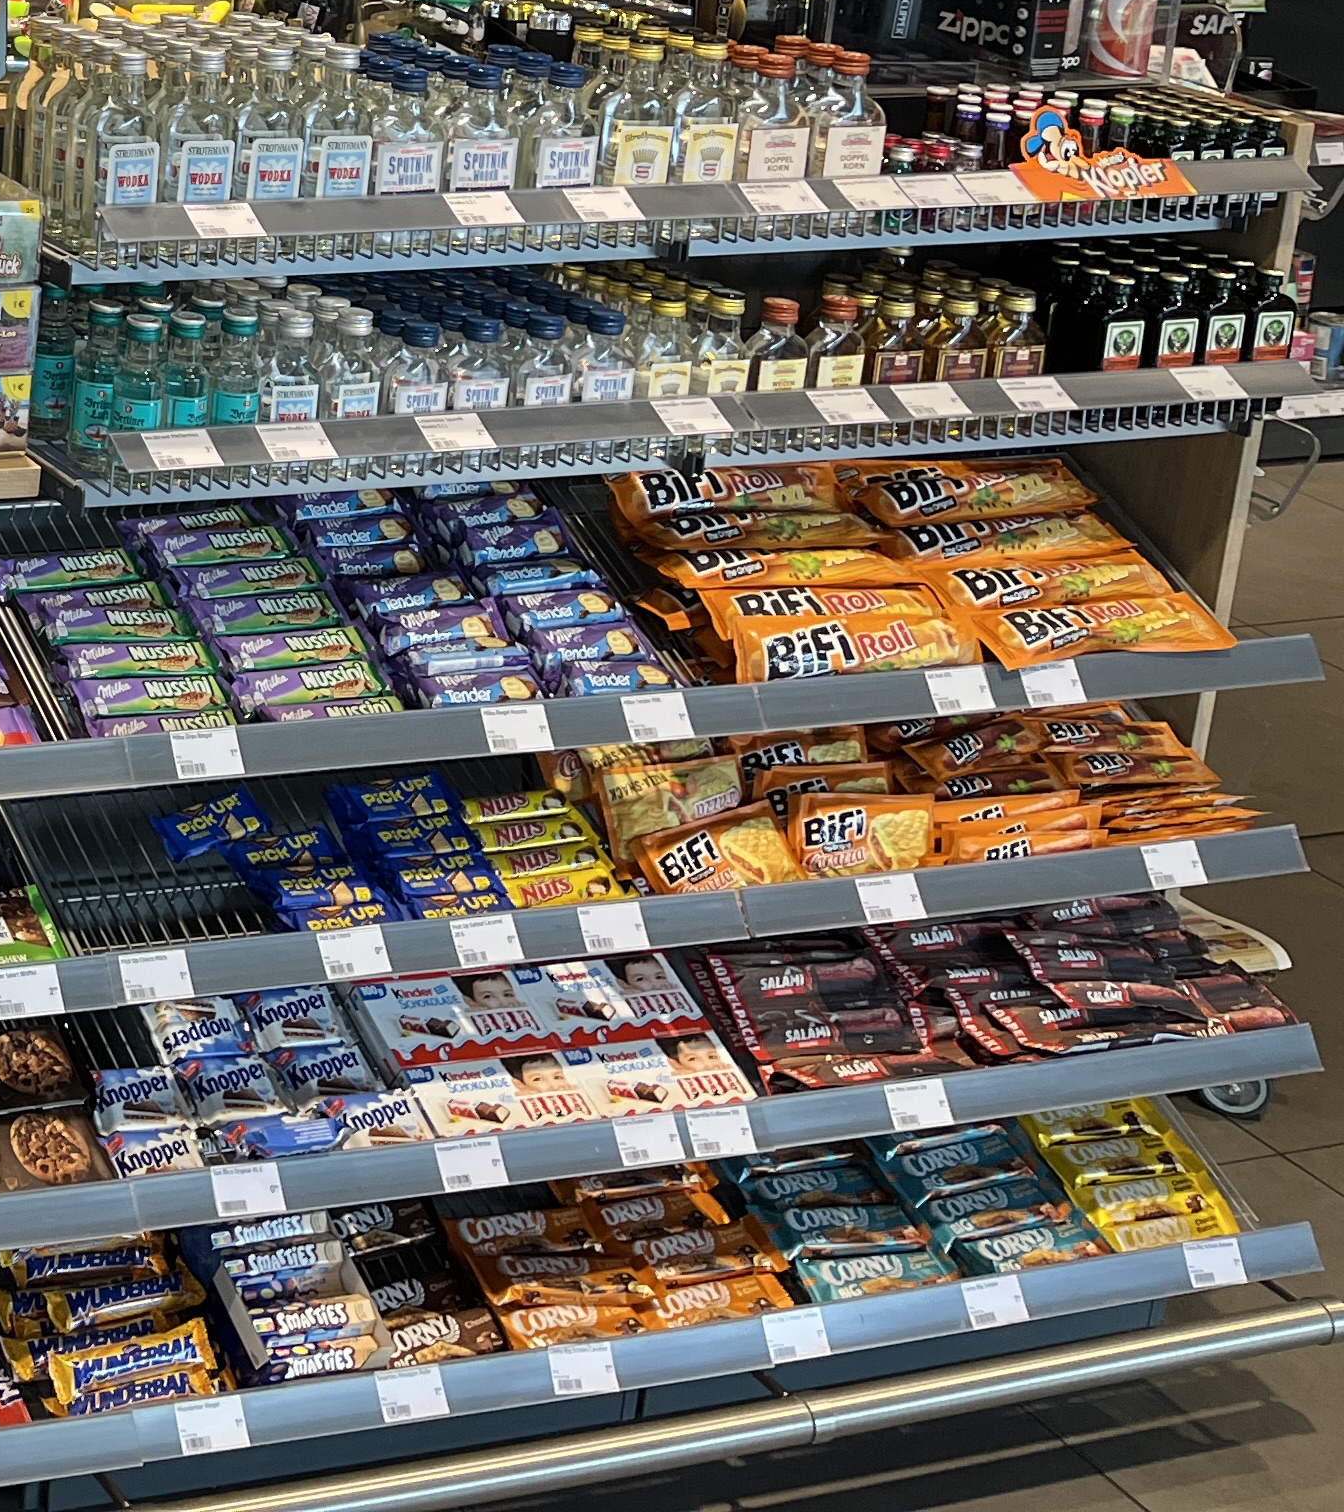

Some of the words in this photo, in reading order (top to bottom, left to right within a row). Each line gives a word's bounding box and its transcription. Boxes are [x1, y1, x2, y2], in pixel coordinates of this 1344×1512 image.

[388, 155, 433, 175] SPUTNIK
[464, 150, 508, 172] SPUTNIK
[763, 155, 795, 167] DOPPEL
[772, 166, 795, 176] KORN
[190, 171, 223, 186] WODKA
[1083, 160, 1167, 199] Klopfer
[857, 623, 917, 663] Roll
[445, 689, 491, 703] Tender
[391, 984, 433, 1001] kinder
[819, 1253, 904, 1286] CORNY
[71, 1336, 195, 1385] WUNDERBAR
